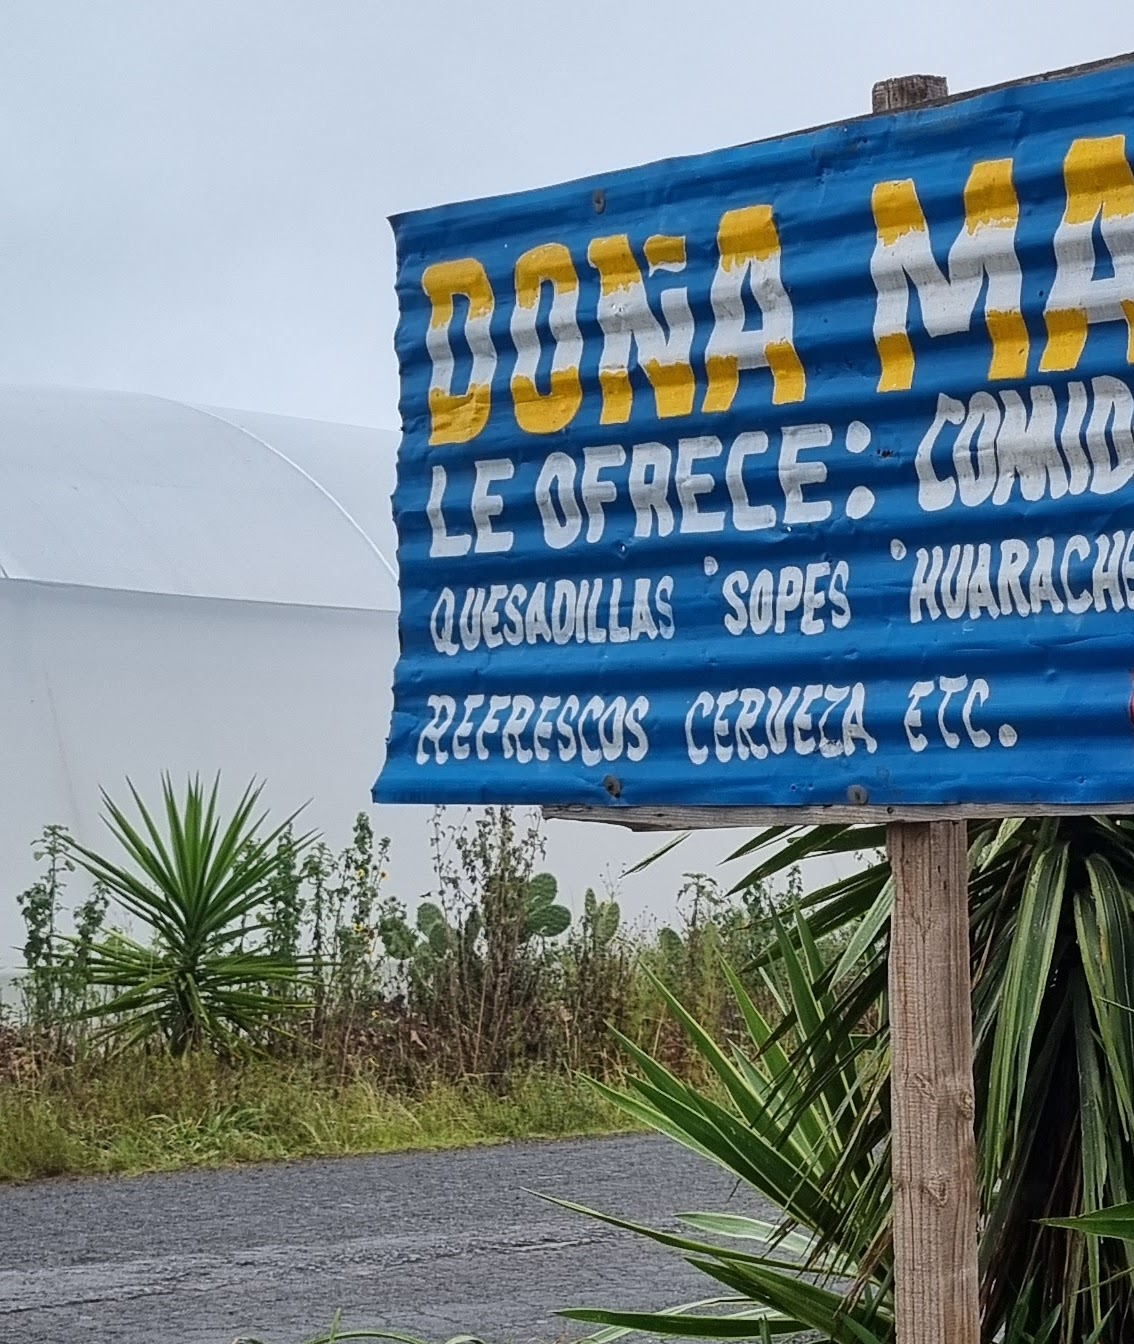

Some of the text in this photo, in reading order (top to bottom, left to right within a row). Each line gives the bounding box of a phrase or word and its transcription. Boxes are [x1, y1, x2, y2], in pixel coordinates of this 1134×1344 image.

[422, 205, 806, 445] DOÑA
[427, 458, 515, 558] LE
[535, 420, 876, 550] OFRECE:
[430, 575, 676, 655] QUESADILLAS
[722, 561, 851, 636] SOPES
[415, 674, 1018, 766] REFRESCOS CERVEZA ETC.
